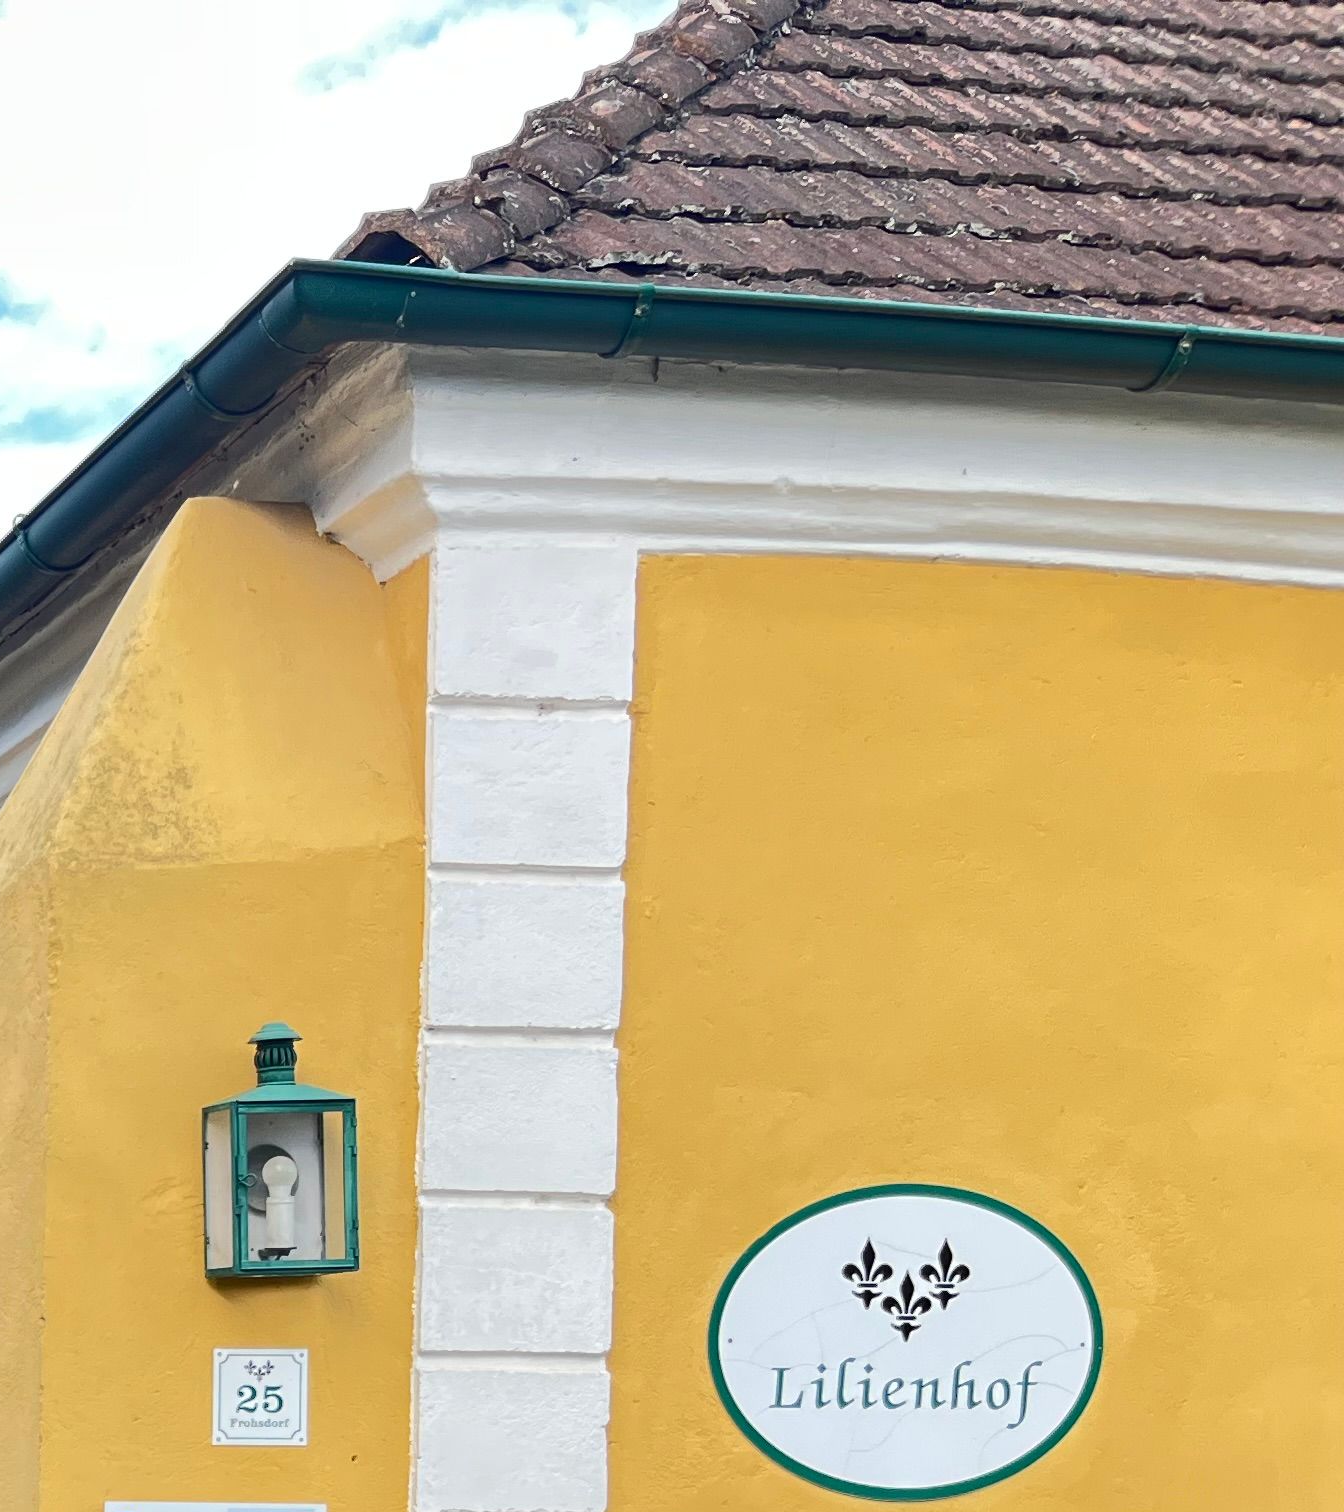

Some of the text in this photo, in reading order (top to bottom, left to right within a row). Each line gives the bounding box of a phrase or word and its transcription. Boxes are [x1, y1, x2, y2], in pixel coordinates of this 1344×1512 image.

[235, 1384, 284, 1414] 25
[768, 1357, 1043, 1430] Lilienhof
[229, 1418, 290, 1428] Frohsdorf
